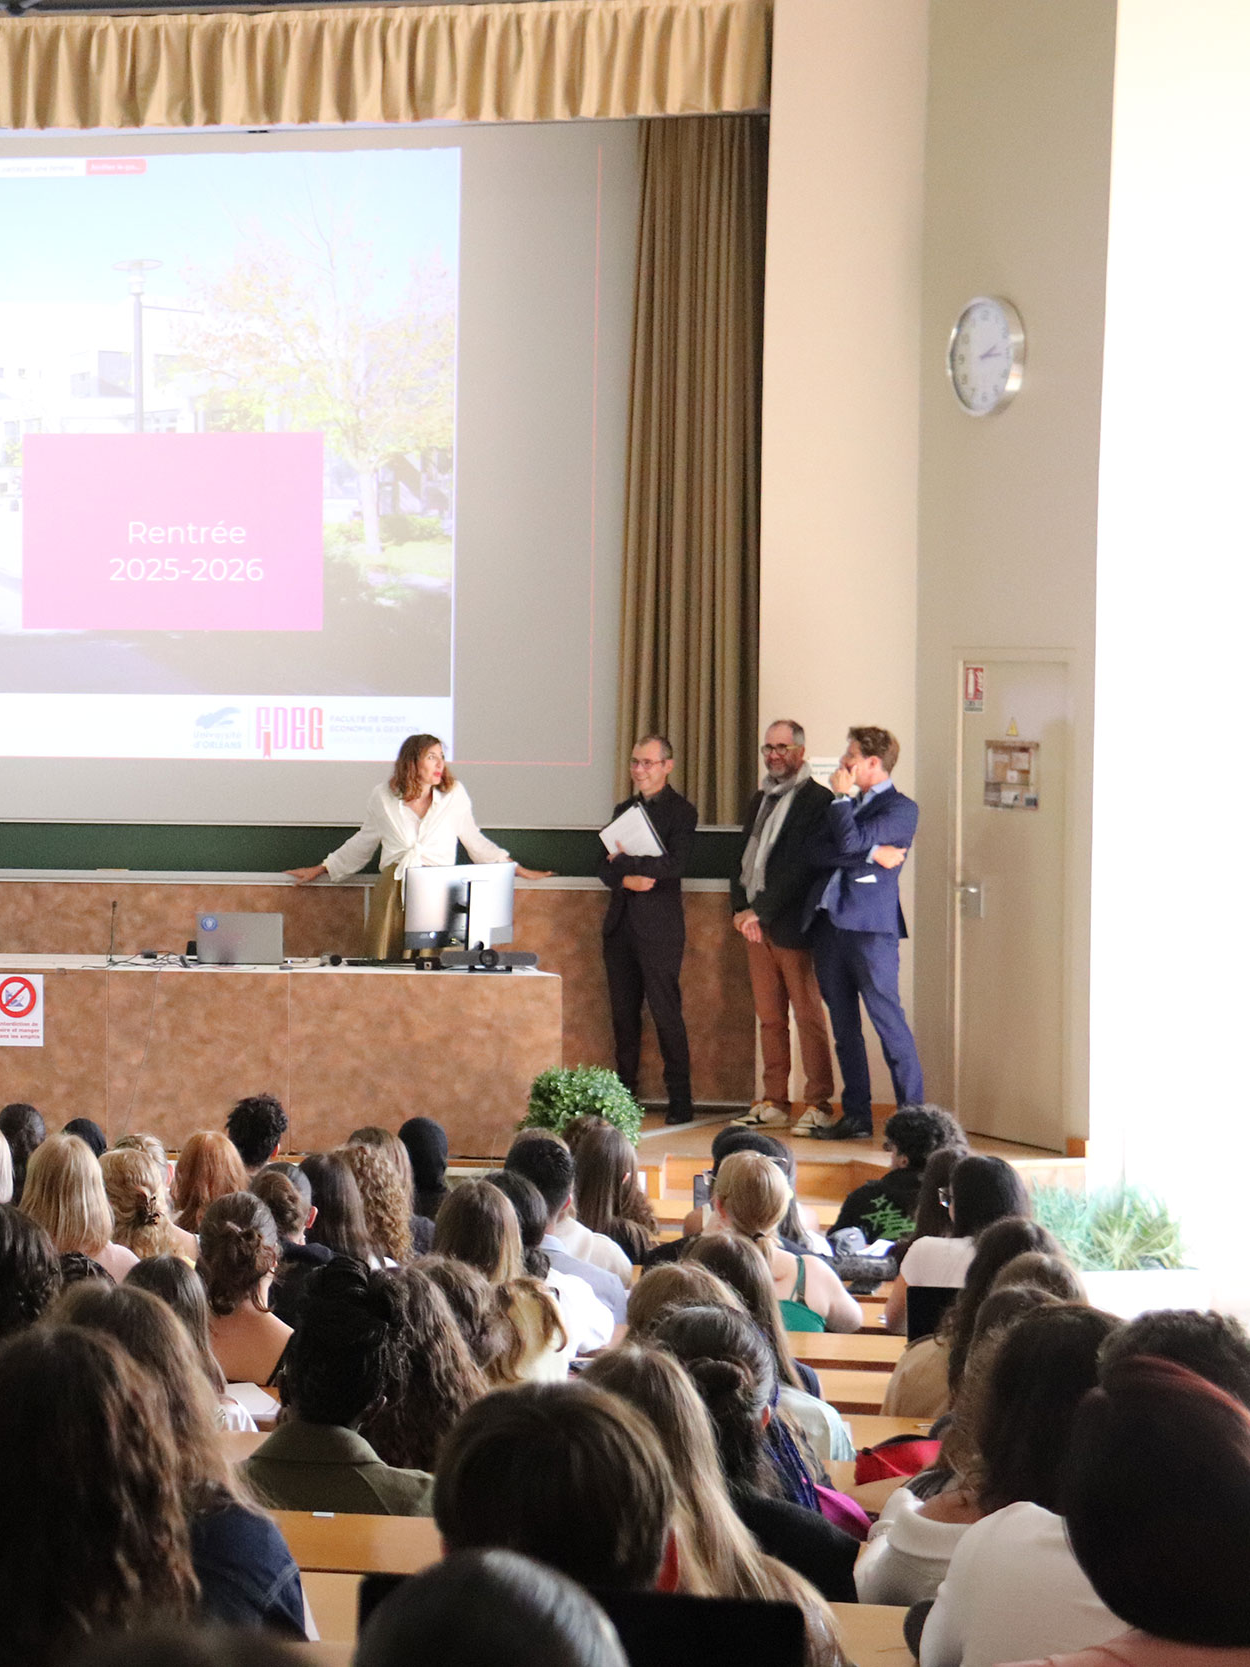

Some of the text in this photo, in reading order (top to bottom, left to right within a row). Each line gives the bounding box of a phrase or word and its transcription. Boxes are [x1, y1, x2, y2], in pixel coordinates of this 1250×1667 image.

[128, 520, 246, 544] Rentrée
[109, 558, 264, 582] 2025-2026
[256, 706, 324, 759] FDEG
